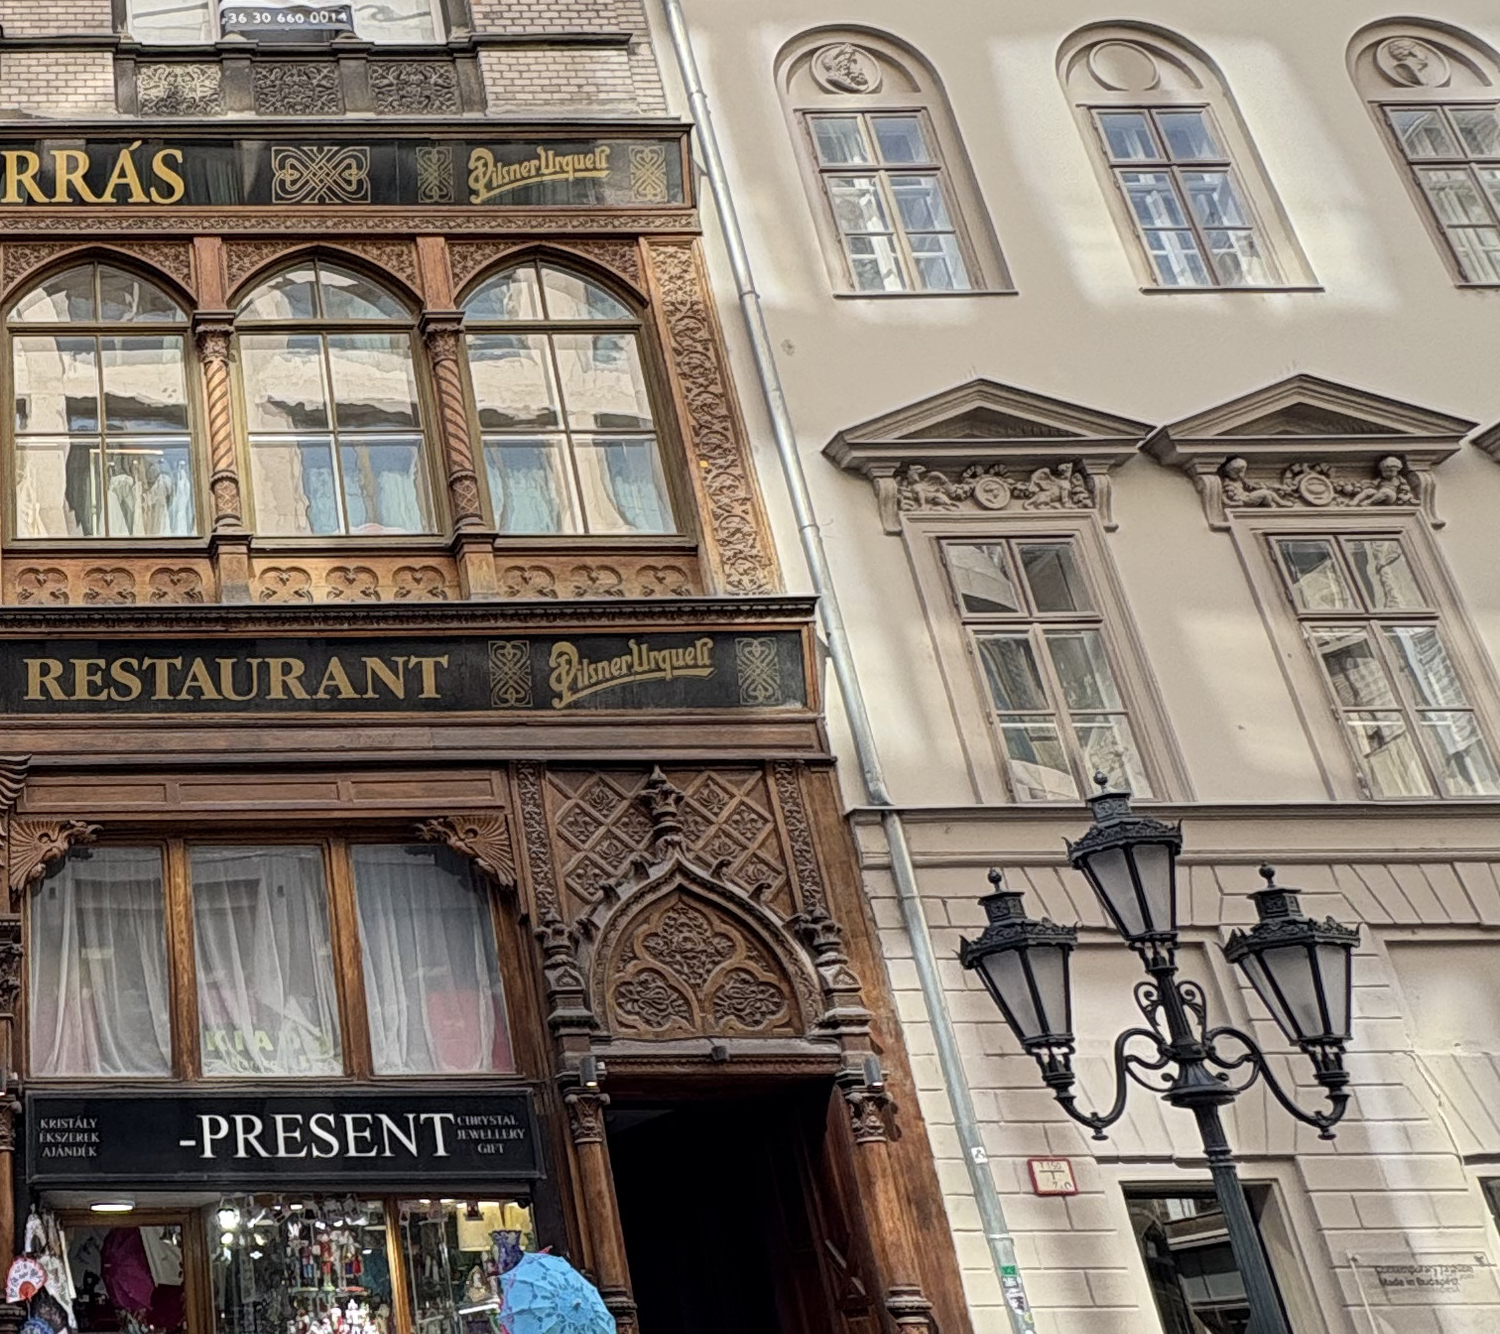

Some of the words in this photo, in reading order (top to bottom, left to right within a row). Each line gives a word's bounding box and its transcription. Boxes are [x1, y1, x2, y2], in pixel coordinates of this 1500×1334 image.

[253, 12, 271, 24] 30
[276, 12, 305, 24] 660
[309, 11, 347, 23] 0014
[468, 147, 540, 204] Pilsner
[536, 146, 611, 181] Urquell
[23, 654, 449, 702] RESTAURANT
[549, 641, 634, 709] Pilsner
[628, 637, 714, 681] Urquell
[40, 1116, 98, 1129] KRISTÁLY
[39, 1130, 100, 1143] ÉKSZEREK
[42, 1144, 97, 1157] AJÁNDÉK
